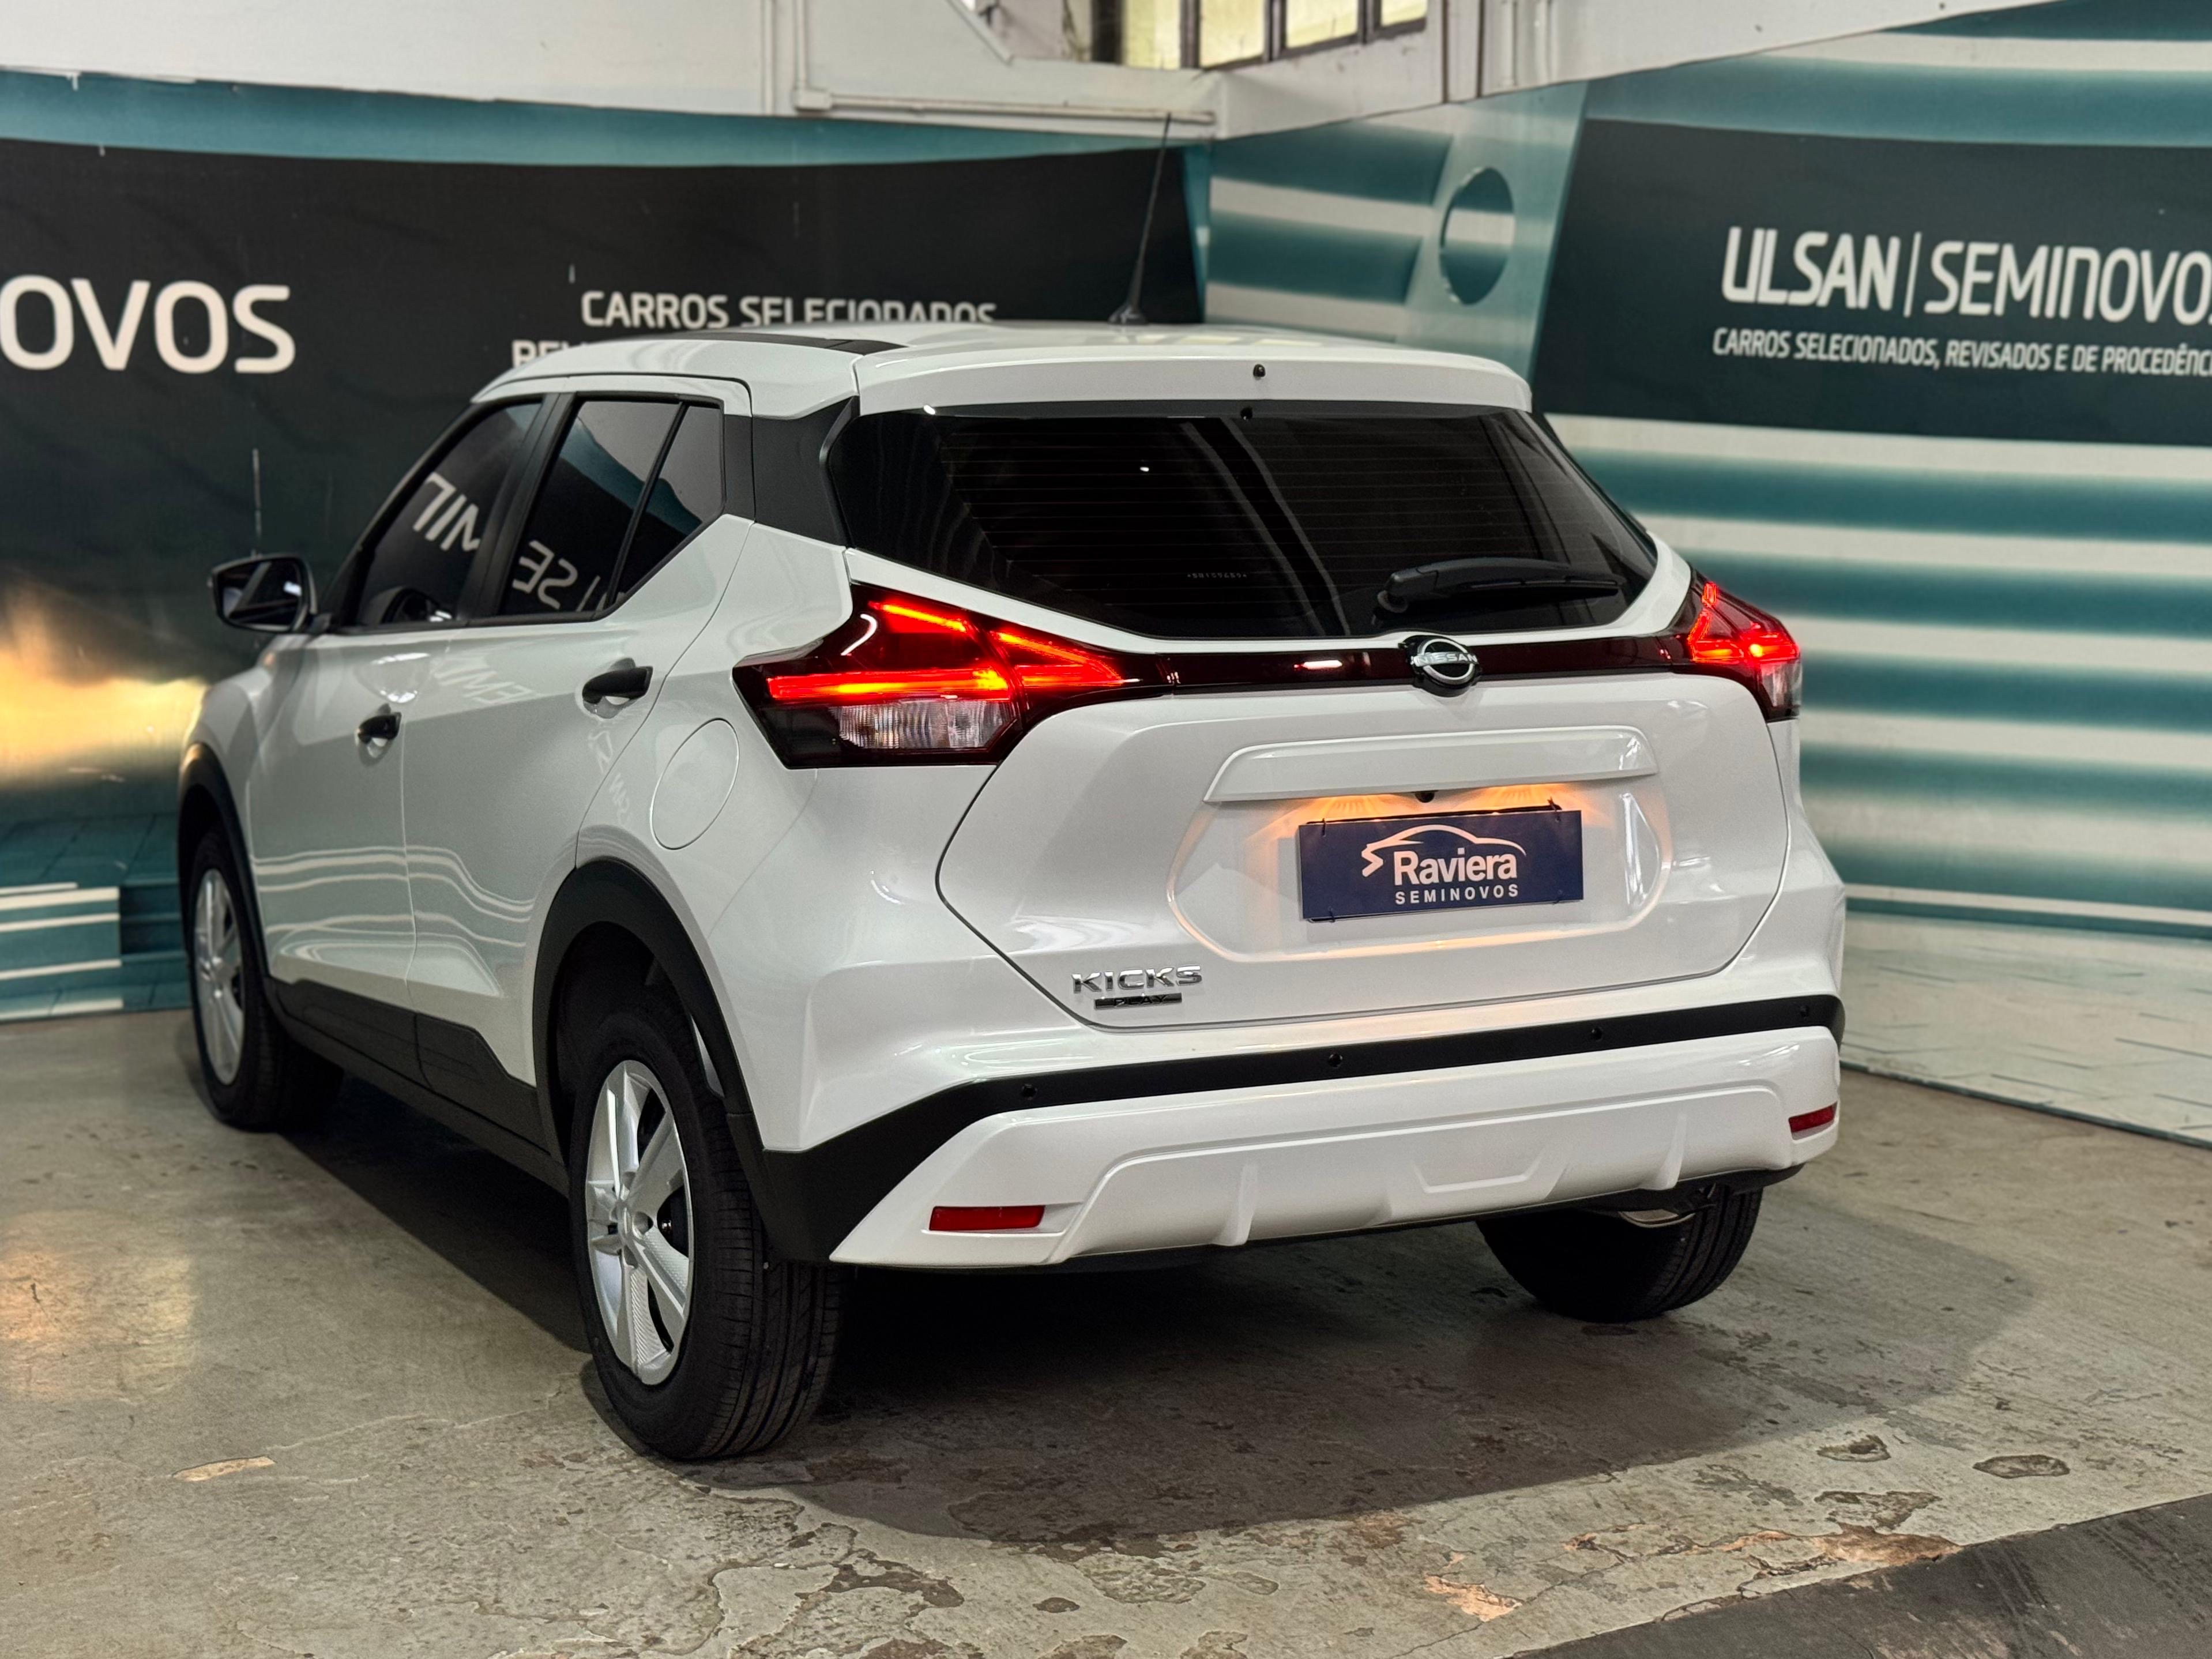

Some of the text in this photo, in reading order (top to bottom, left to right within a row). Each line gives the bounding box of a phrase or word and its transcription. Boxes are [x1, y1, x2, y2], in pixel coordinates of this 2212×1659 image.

[1722, 227, 2212, 325] ULSAN SEMINOVO
[0, 274, 295, 373] OVOS
[581, 290, 729, 329] CARROS
[1713, 328, 1791, 359] CARROS
[1793, 332, 1940, 370] SELECIONADOS,
[1945, 340, 2052, 371] REVISADOS
[2054, 343, 2070, 371] E
[2071, 344, 2099, 373] DE
[1413, 652, 1479, 667] NISSAN
[1393, 847, 1517, 886] Raviera
[1395, 883, 1519, 905] SEMINOVOS
[1071, 964, 1203, 994] KICKS
